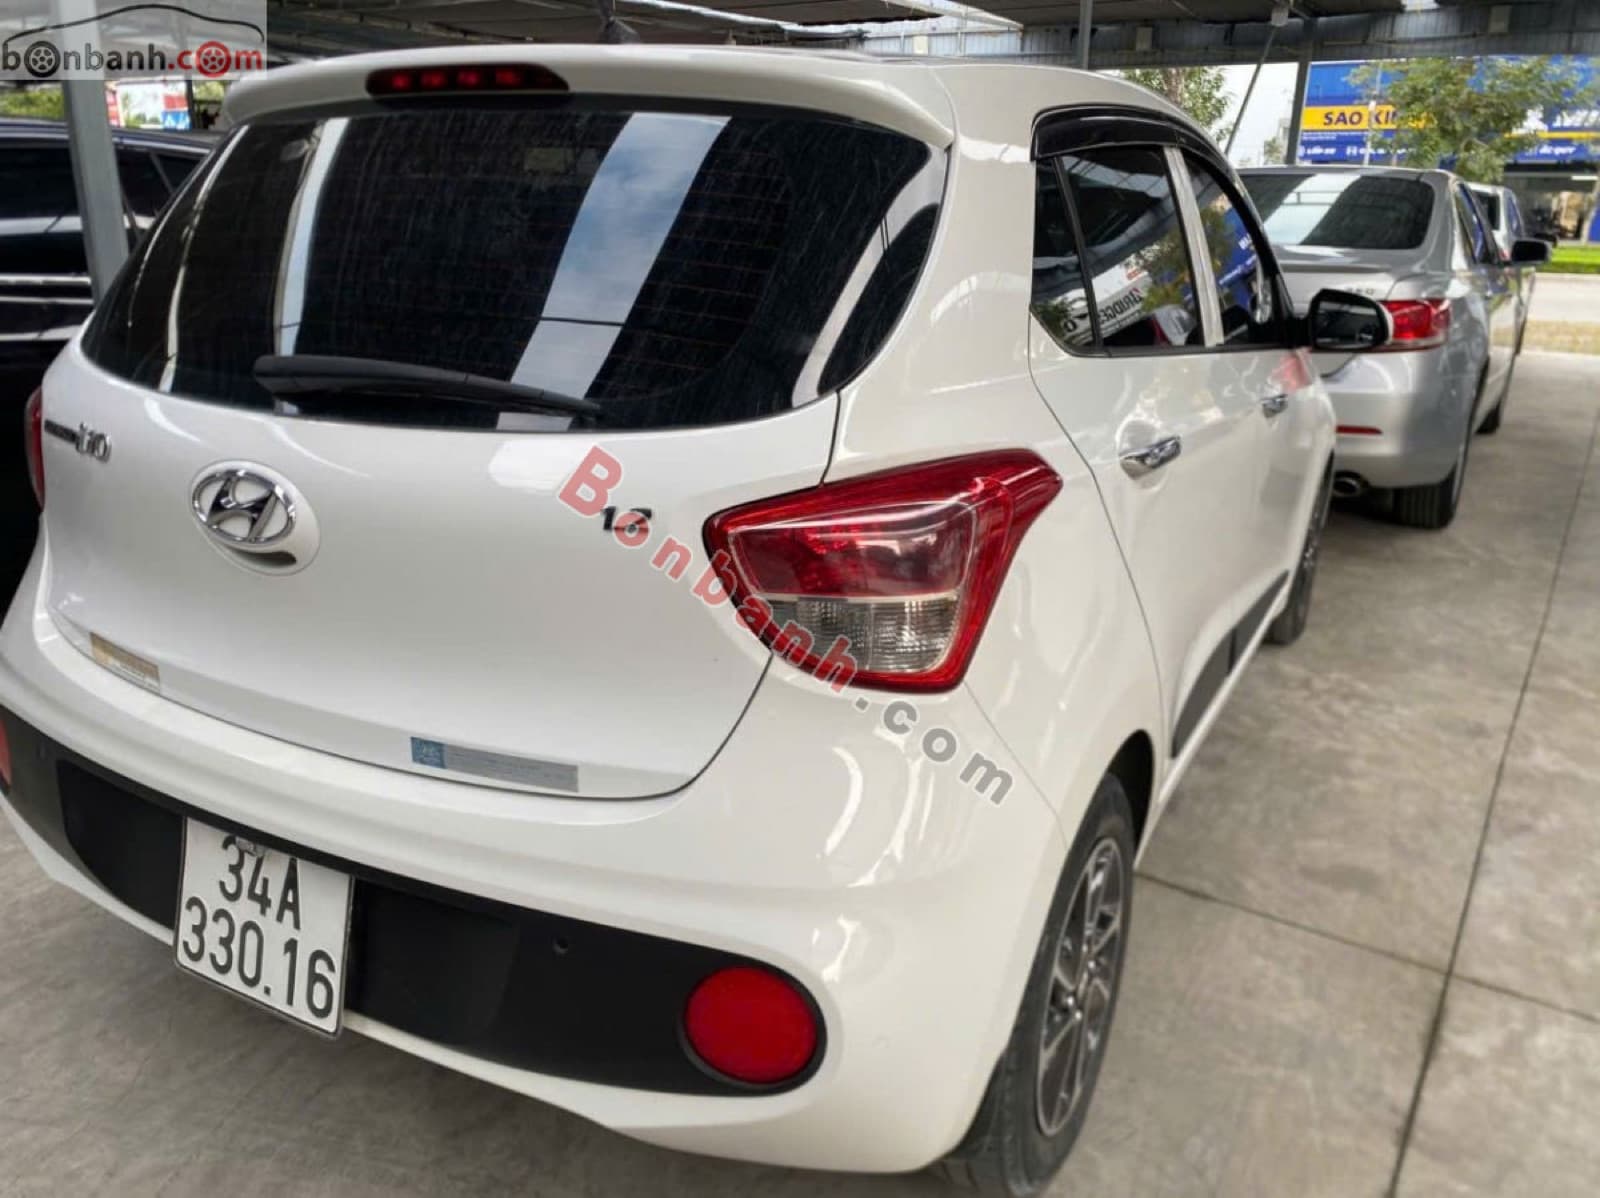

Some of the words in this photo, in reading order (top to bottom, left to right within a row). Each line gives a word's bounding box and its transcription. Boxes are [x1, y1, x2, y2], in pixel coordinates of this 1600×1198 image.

[1323, 111, 1363, 127] SAO
[219, 834, 301, 931] 34A
[182, 895, 336, 1019] 330.16
